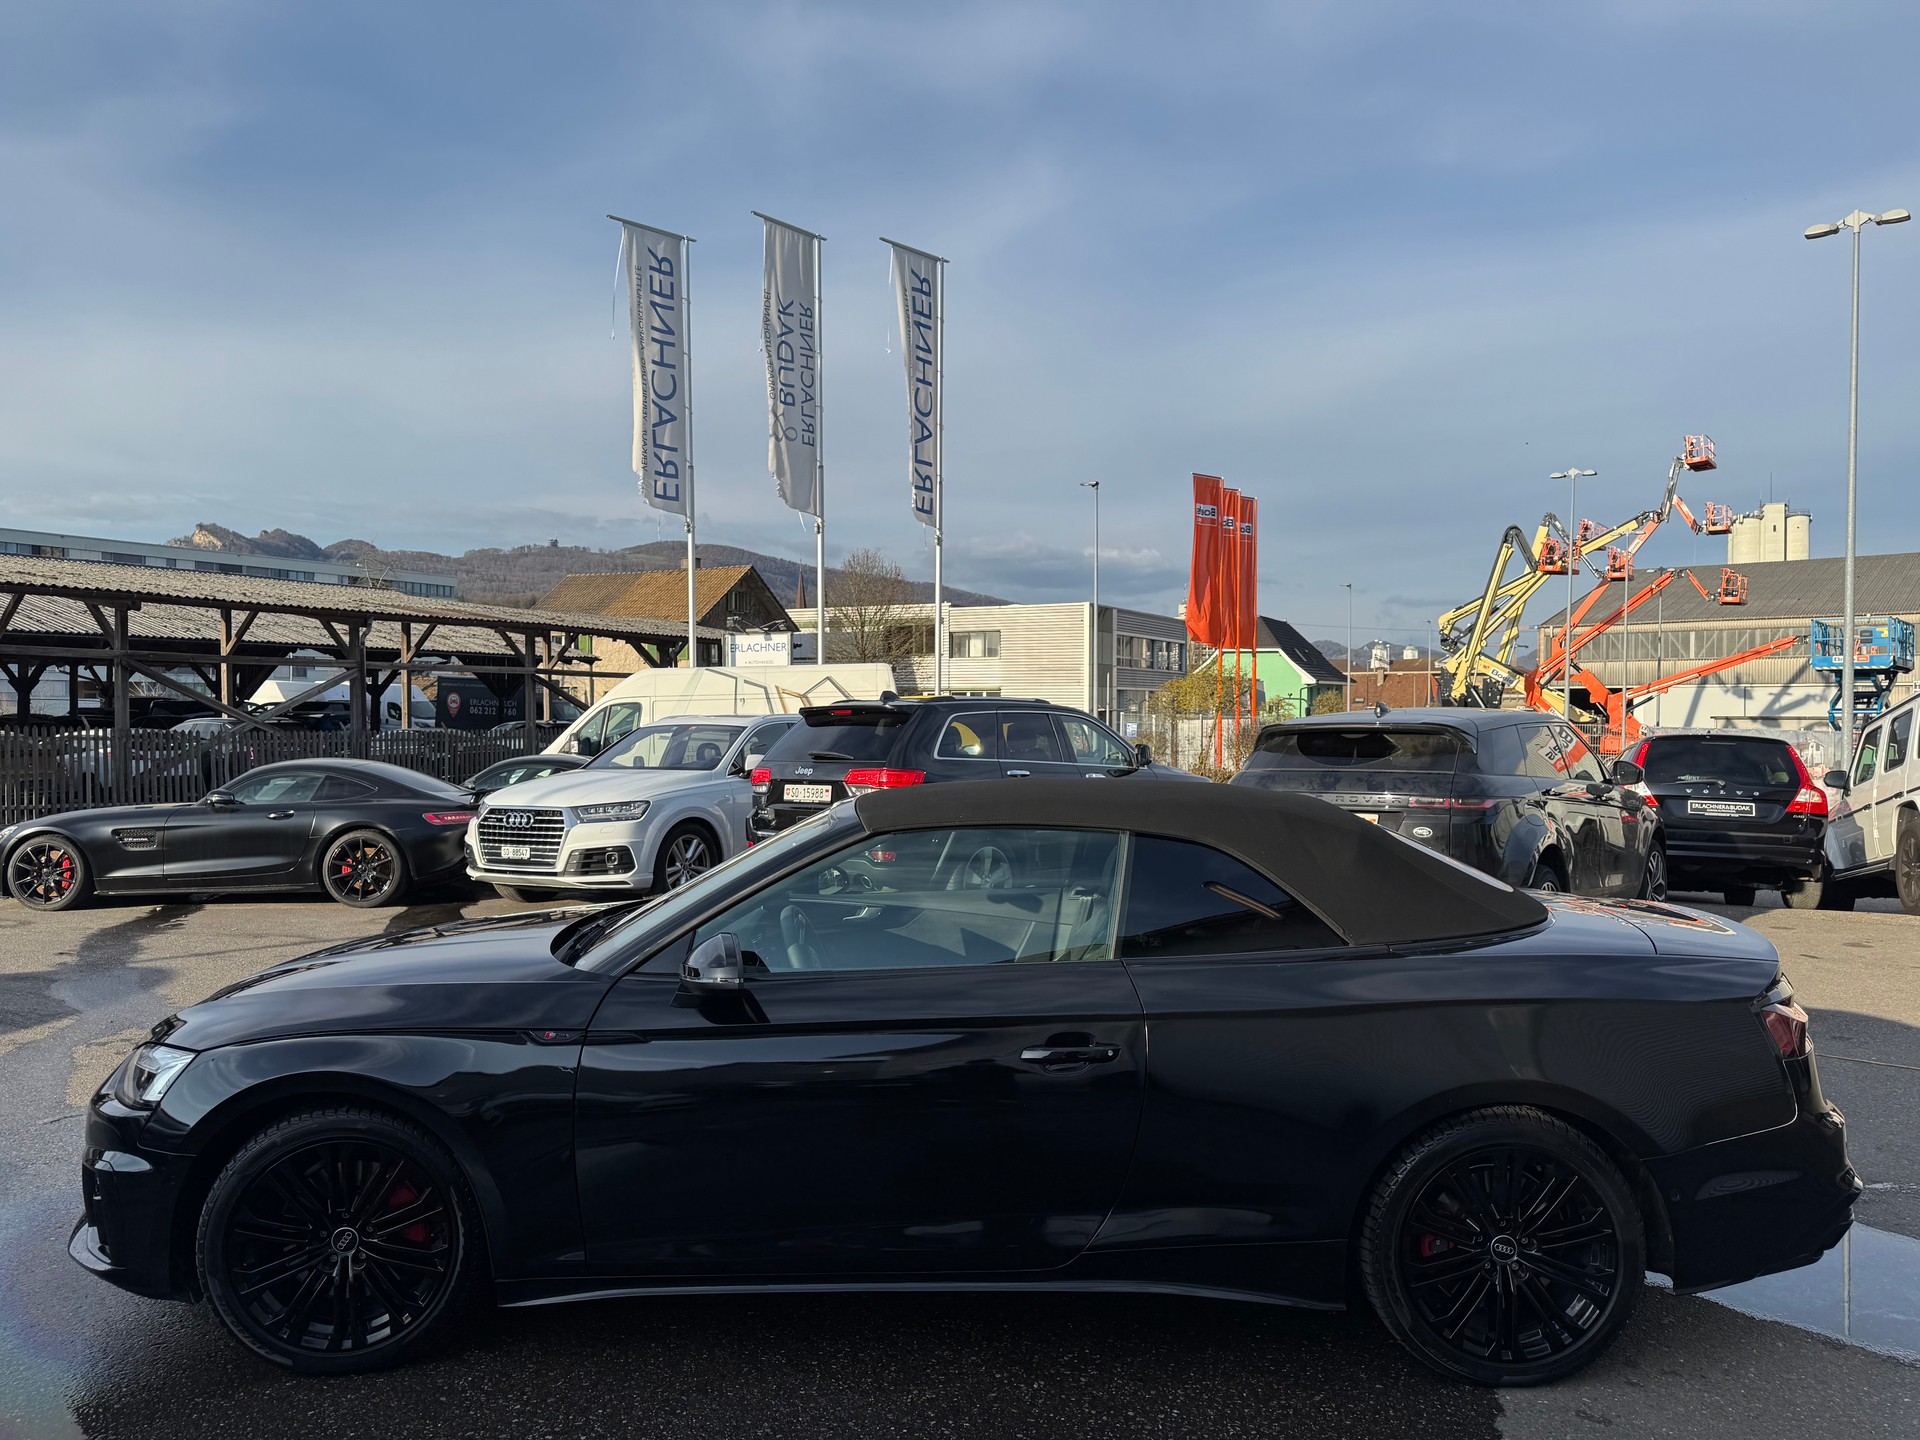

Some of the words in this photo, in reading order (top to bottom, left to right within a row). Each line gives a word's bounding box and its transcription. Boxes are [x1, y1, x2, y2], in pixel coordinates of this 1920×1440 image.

[730, 642, 787, 653] ERLACHNER
[469, 706, 483, 714] 062
[795, 766, 814, 776] Jeep
[1685, 788, 1760, 796] VOLVO
[1335, 796, 1402, 804] ROVER
